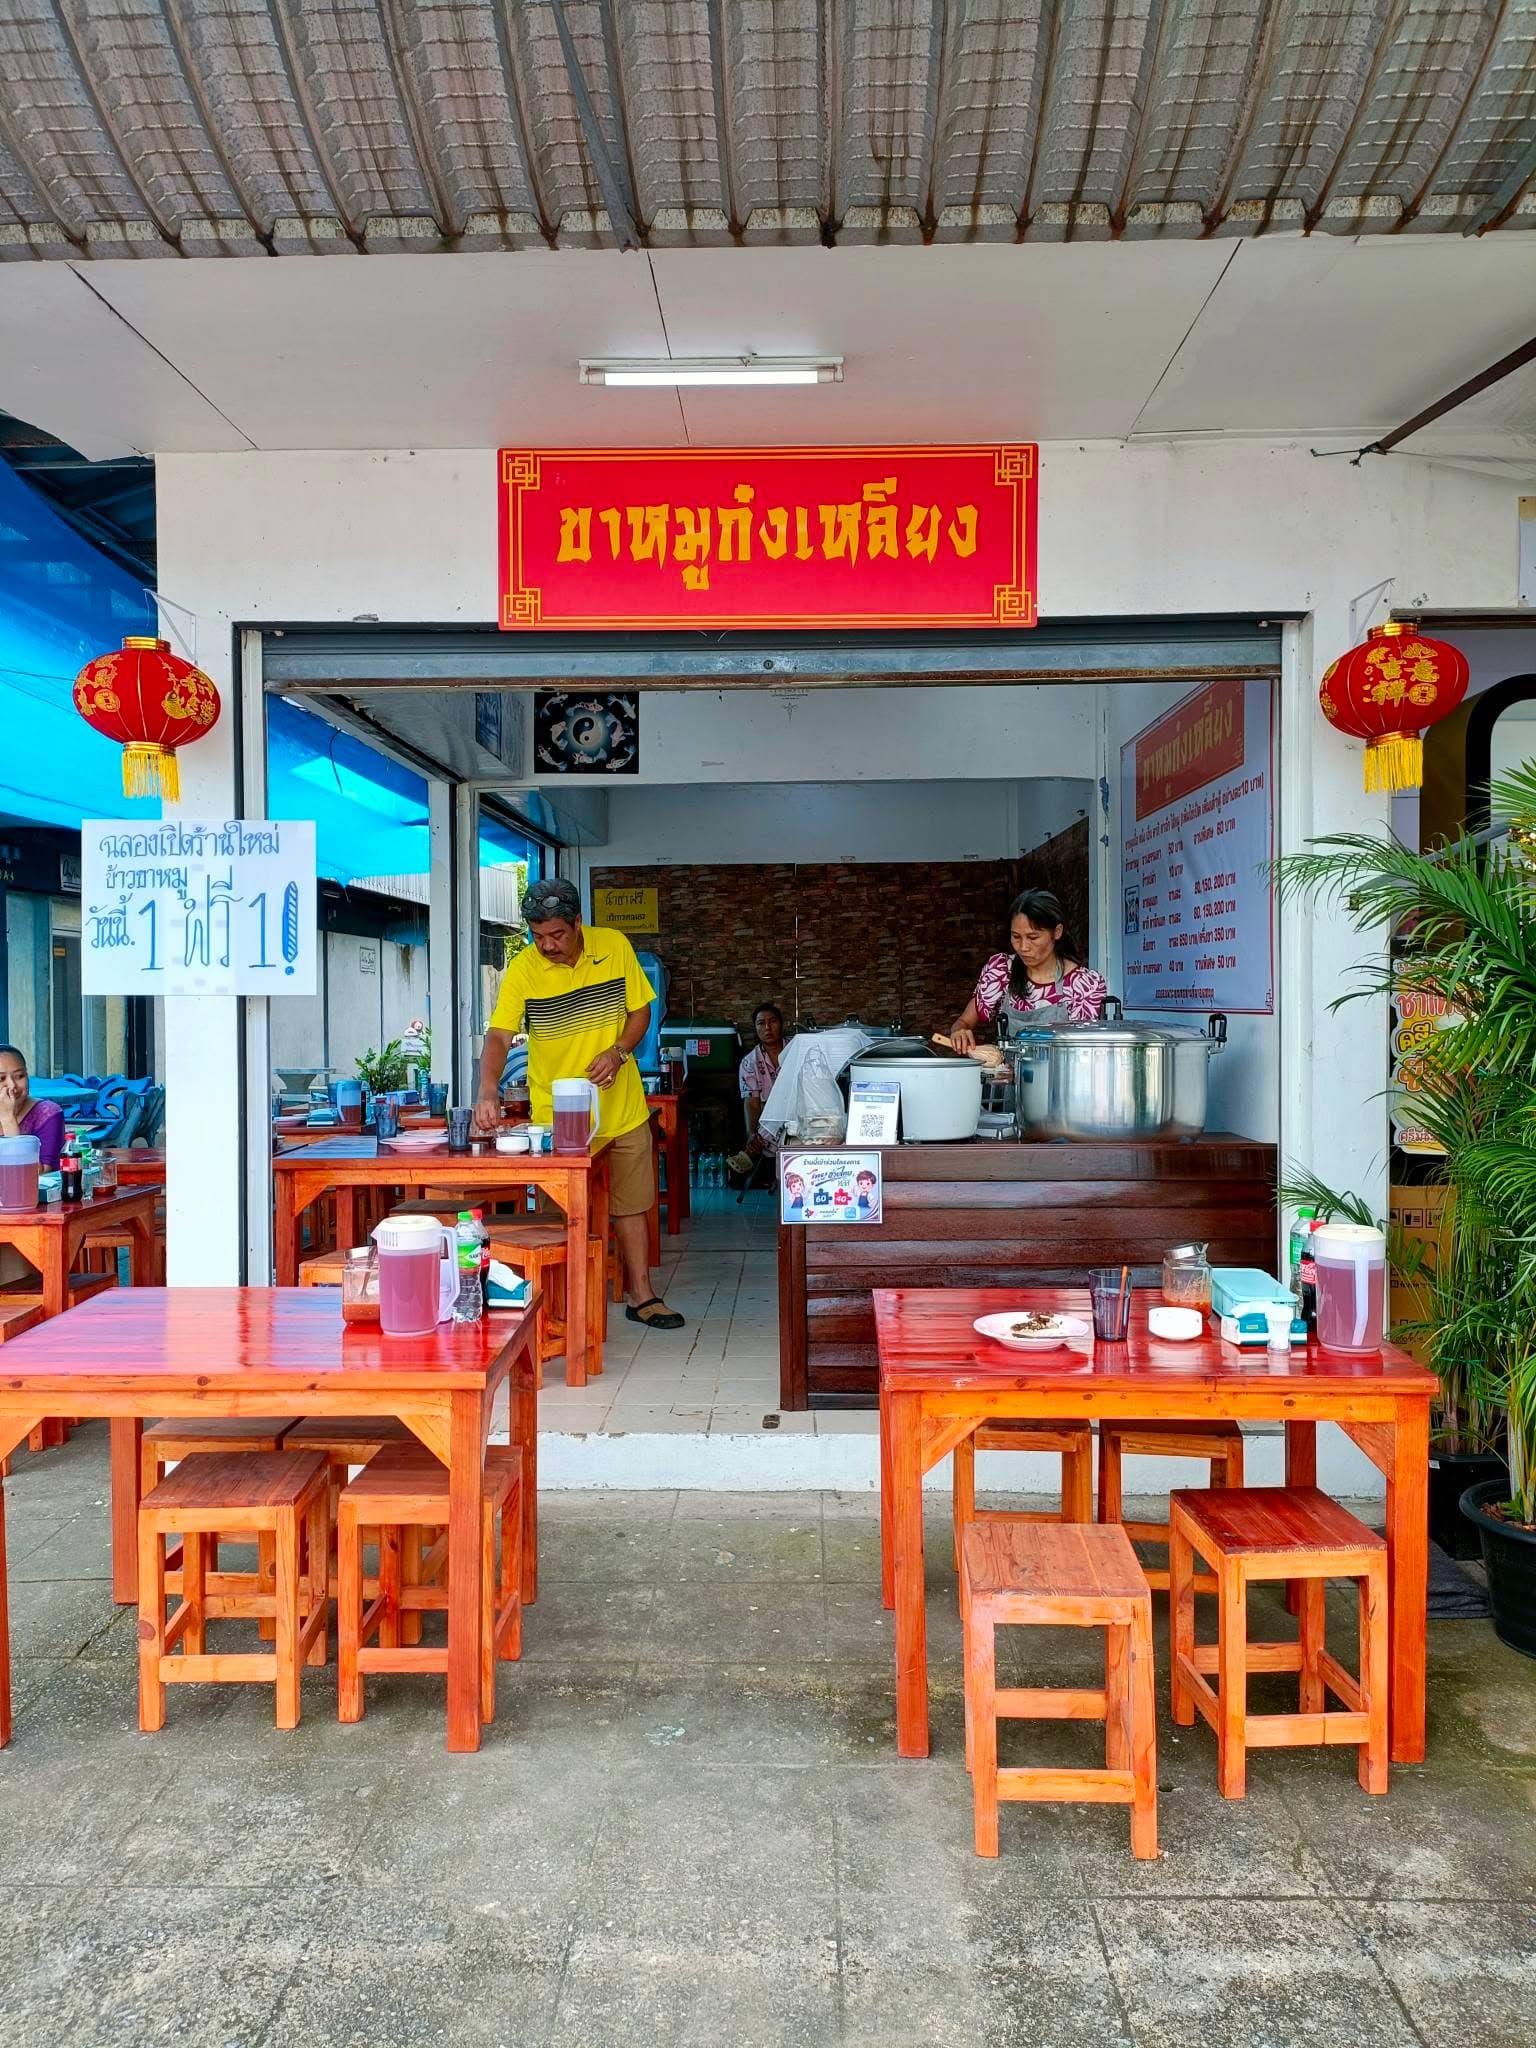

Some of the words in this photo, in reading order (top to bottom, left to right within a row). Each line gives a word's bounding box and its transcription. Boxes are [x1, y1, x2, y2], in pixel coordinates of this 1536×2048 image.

[556, 477, 979, 591] ขาหมูก๋งเหลียง
[99, 821, 280, 858] ฉลองเปิดร้านใหม่
[106, 863, 188, 901] ข้าวขาหมู
[139, 899, 164, 971] 1
[183, 865, 244, 968] ฟรี
[1217, 955, 1225, 969] 50
[816, 1195, 827, 1203] 60
[836, 1195, 847, 1203] 40
